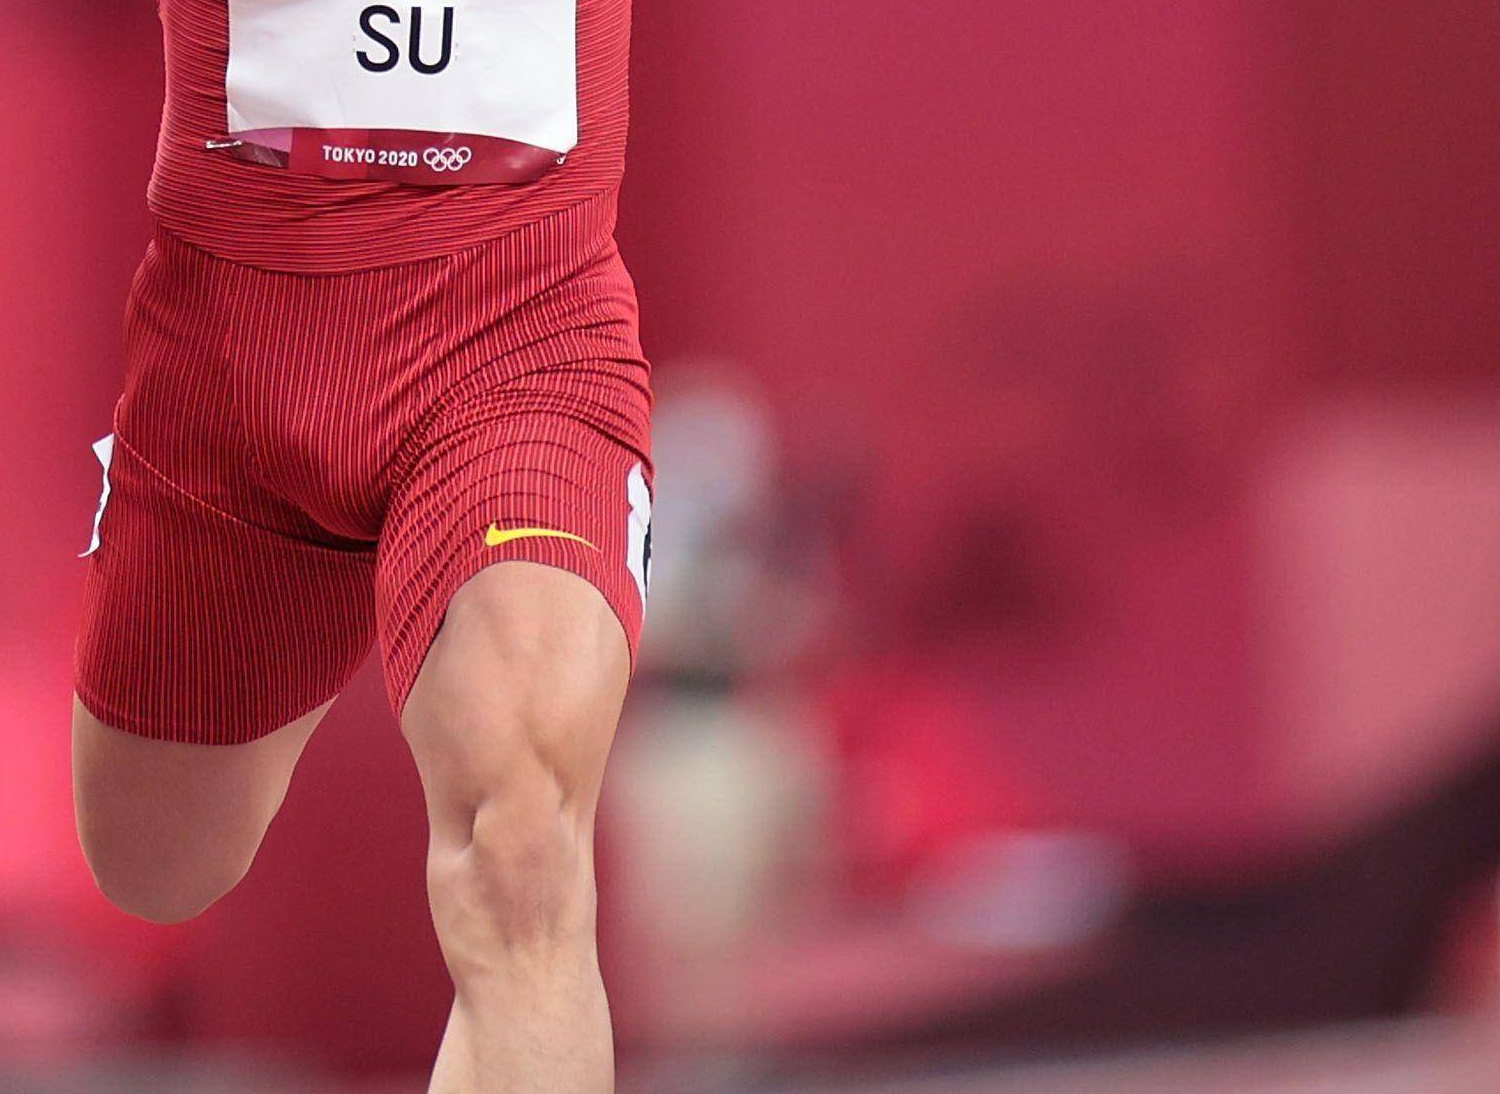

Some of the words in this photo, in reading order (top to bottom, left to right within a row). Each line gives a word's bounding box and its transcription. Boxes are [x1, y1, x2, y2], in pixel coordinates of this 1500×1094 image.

[356, 5, 455, 74] SU
[322, 145, 376, 164] TOKYO
[378, 150, 418, 167] 2020
